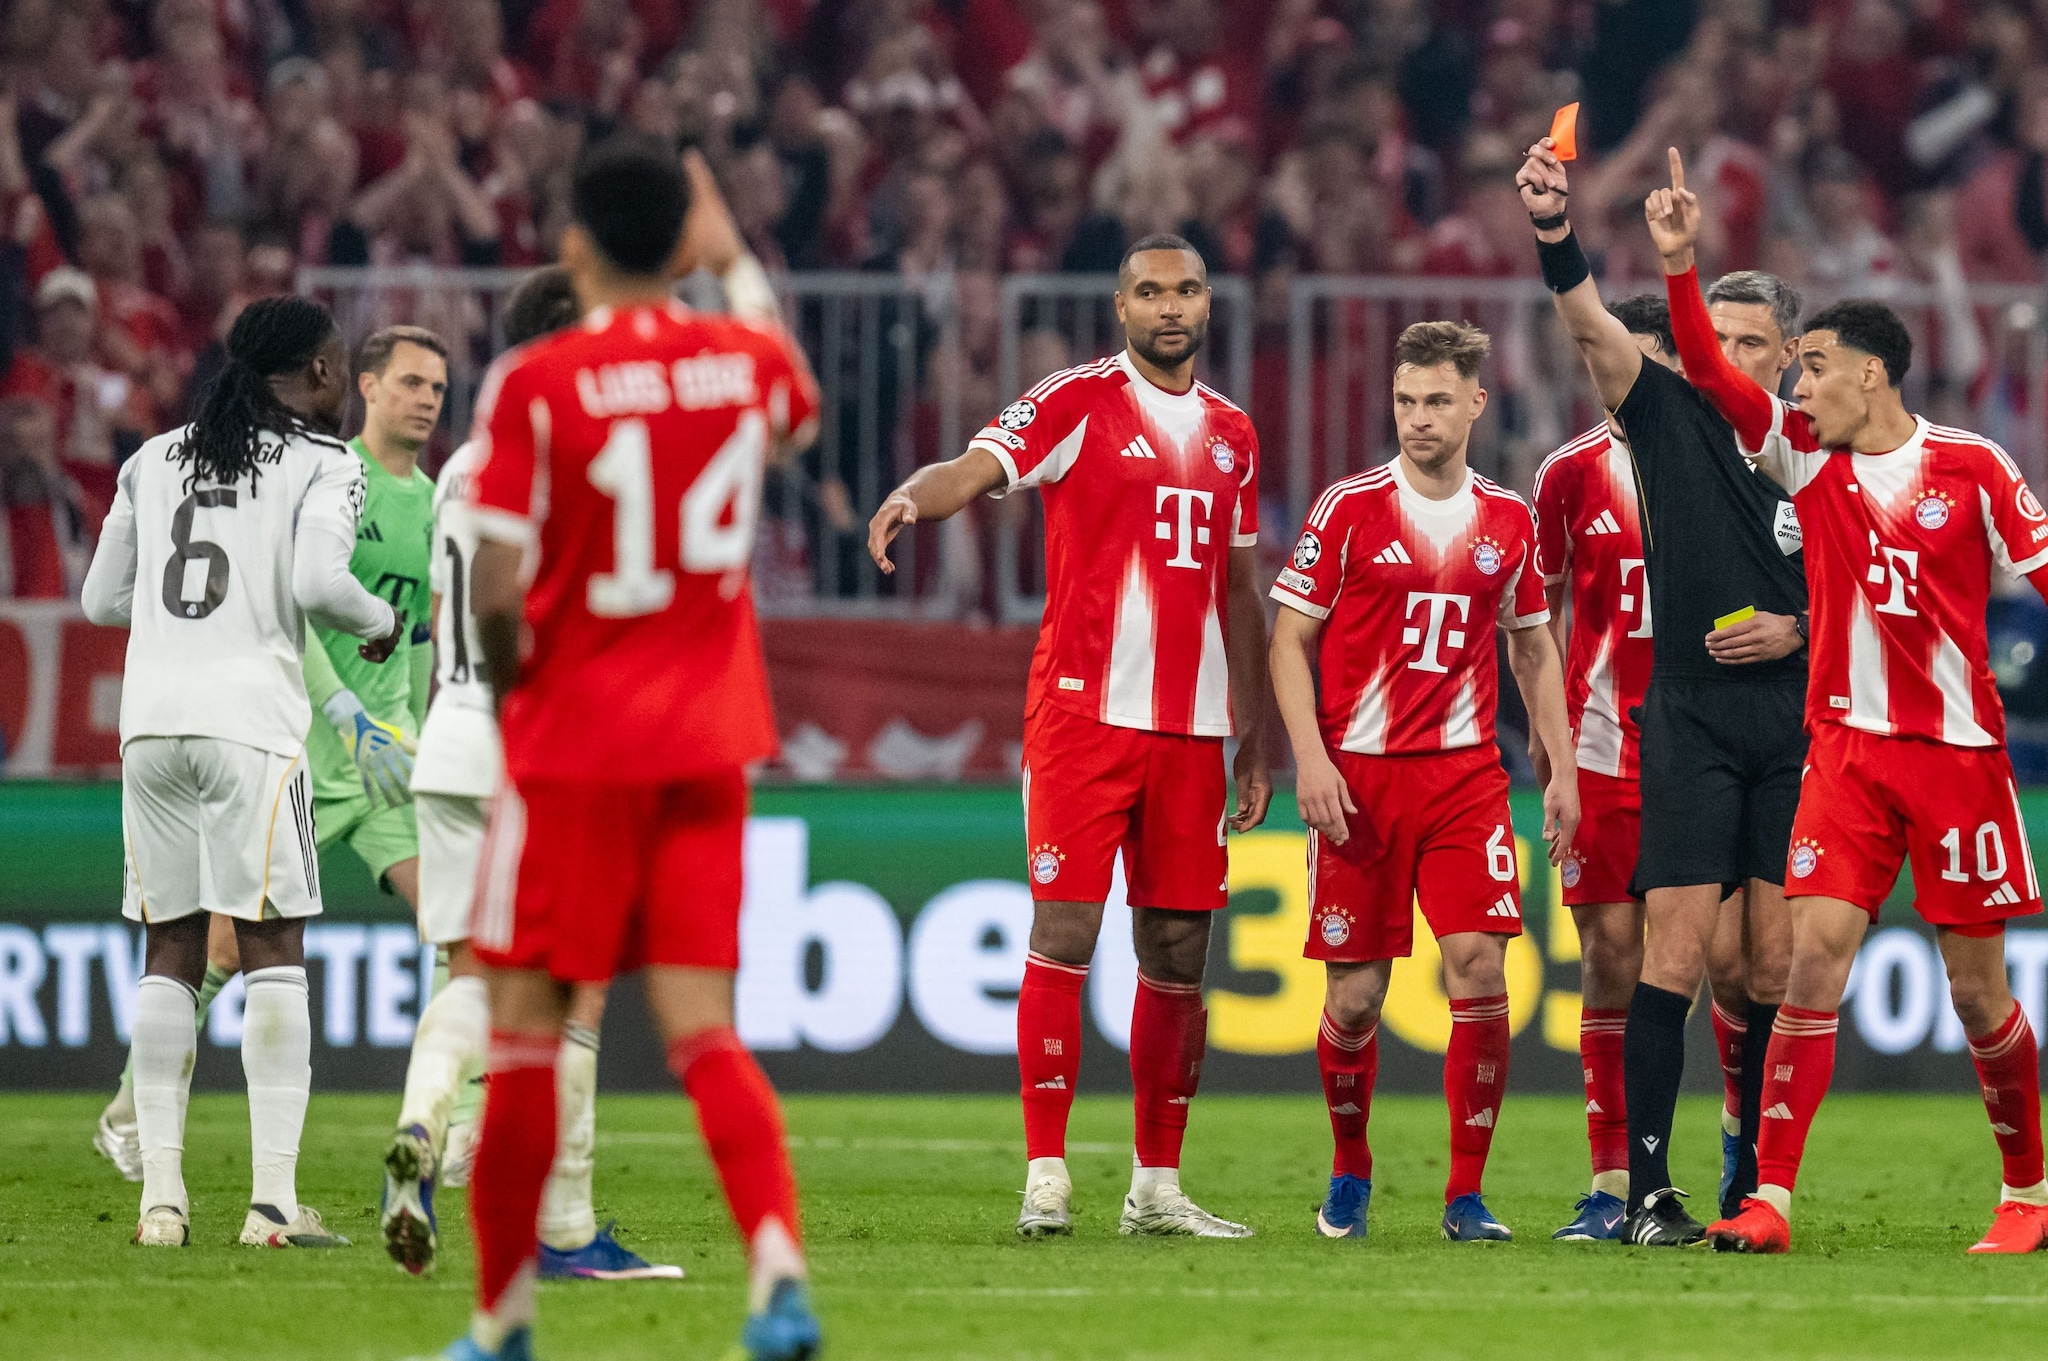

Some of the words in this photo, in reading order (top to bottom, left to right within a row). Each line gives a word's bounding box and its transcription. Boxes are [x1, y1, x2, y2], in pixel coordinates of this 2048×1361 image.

[162, 487, 238, 619] 6
[586, 404, 769, 620] 14
[1155, 485, 1214, 570] T
[1777, 530, 1802, 541] OFFICIA
[1782, 523, 1802, 534] MATC
[1866, 528, 1919, 617] T
[1402, 591, 1471, 674] T
[1485, 824, 1515, 882] 6
[1939, 820, 2008, 883] 10
